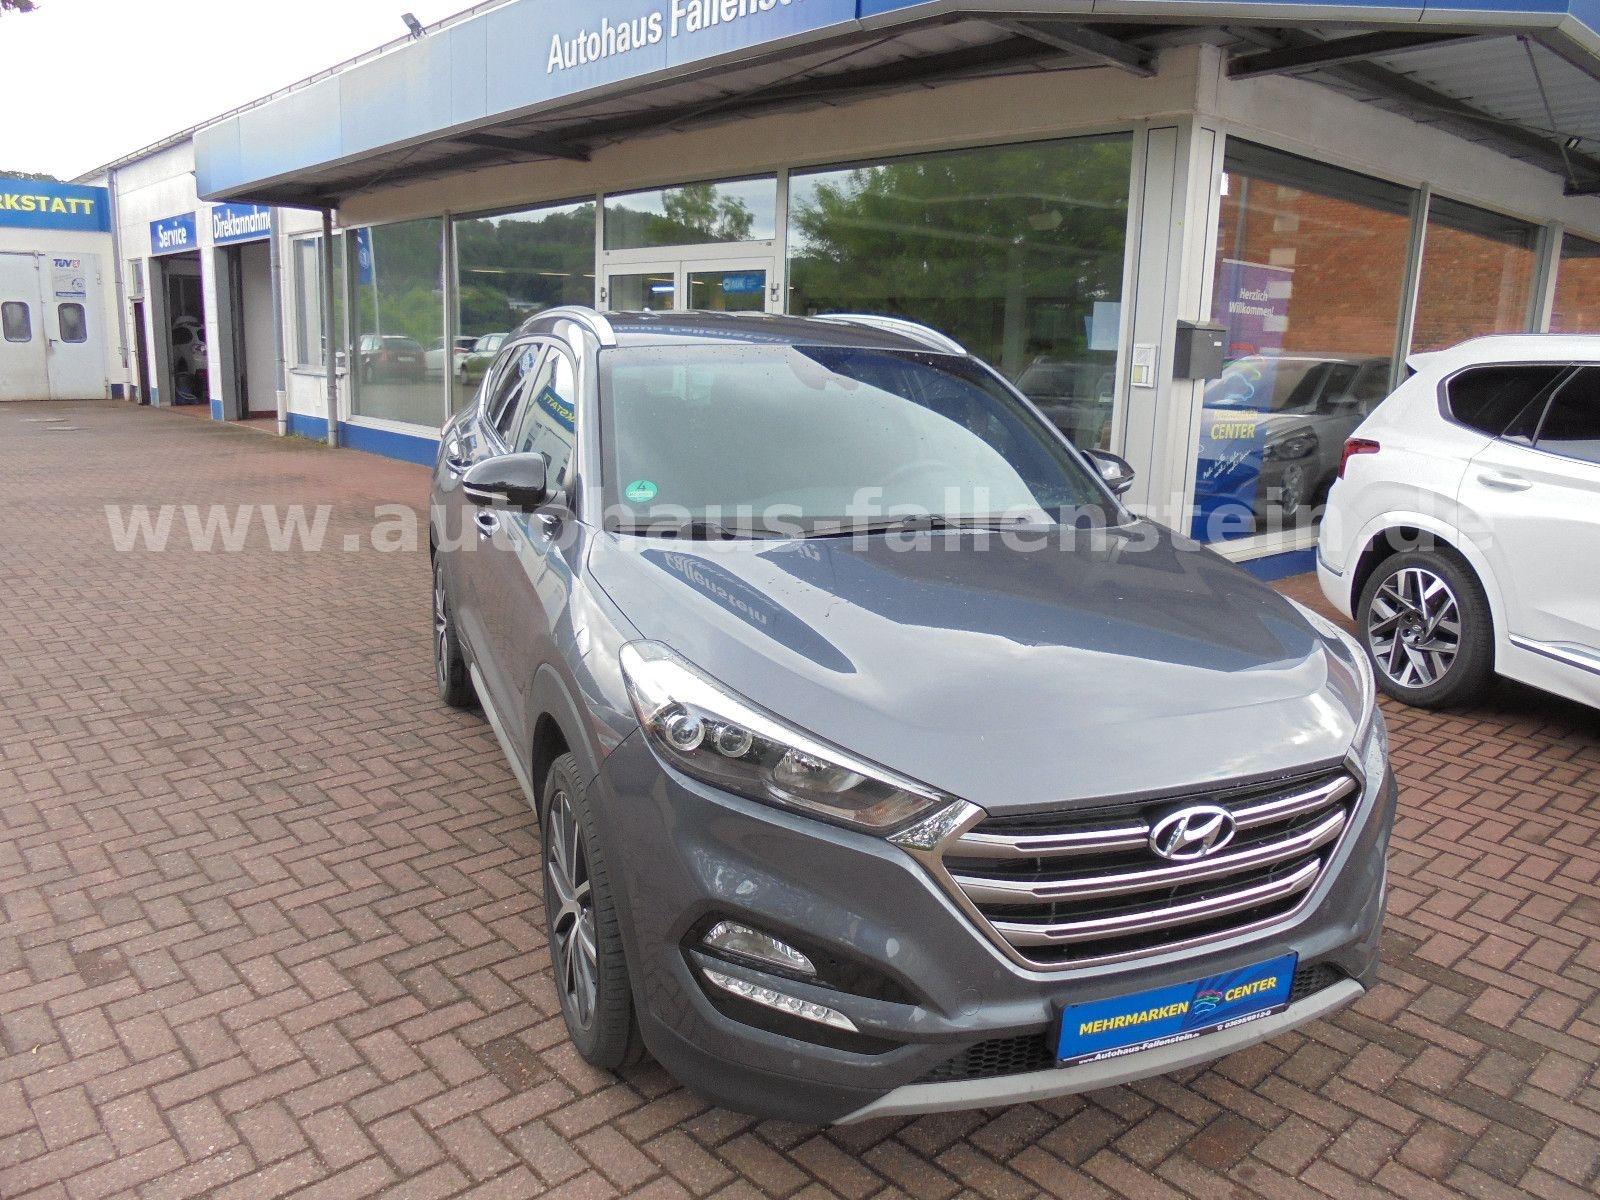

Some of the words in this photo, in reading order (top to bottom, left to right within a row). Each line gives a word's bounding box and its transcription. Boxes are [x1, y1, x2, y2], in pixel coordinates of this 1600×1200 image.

[547, 11, 664, 74] Autohaus
[158, 220, 187, 248] Service
[1240, 287, 1269, 302] Herzlich
[1210, 423, 1256, 440] CENTER
[1079, 1001, 1190, 1036] MEHRMARKEN
[1225, 976, 1277, 1002] CENTER
